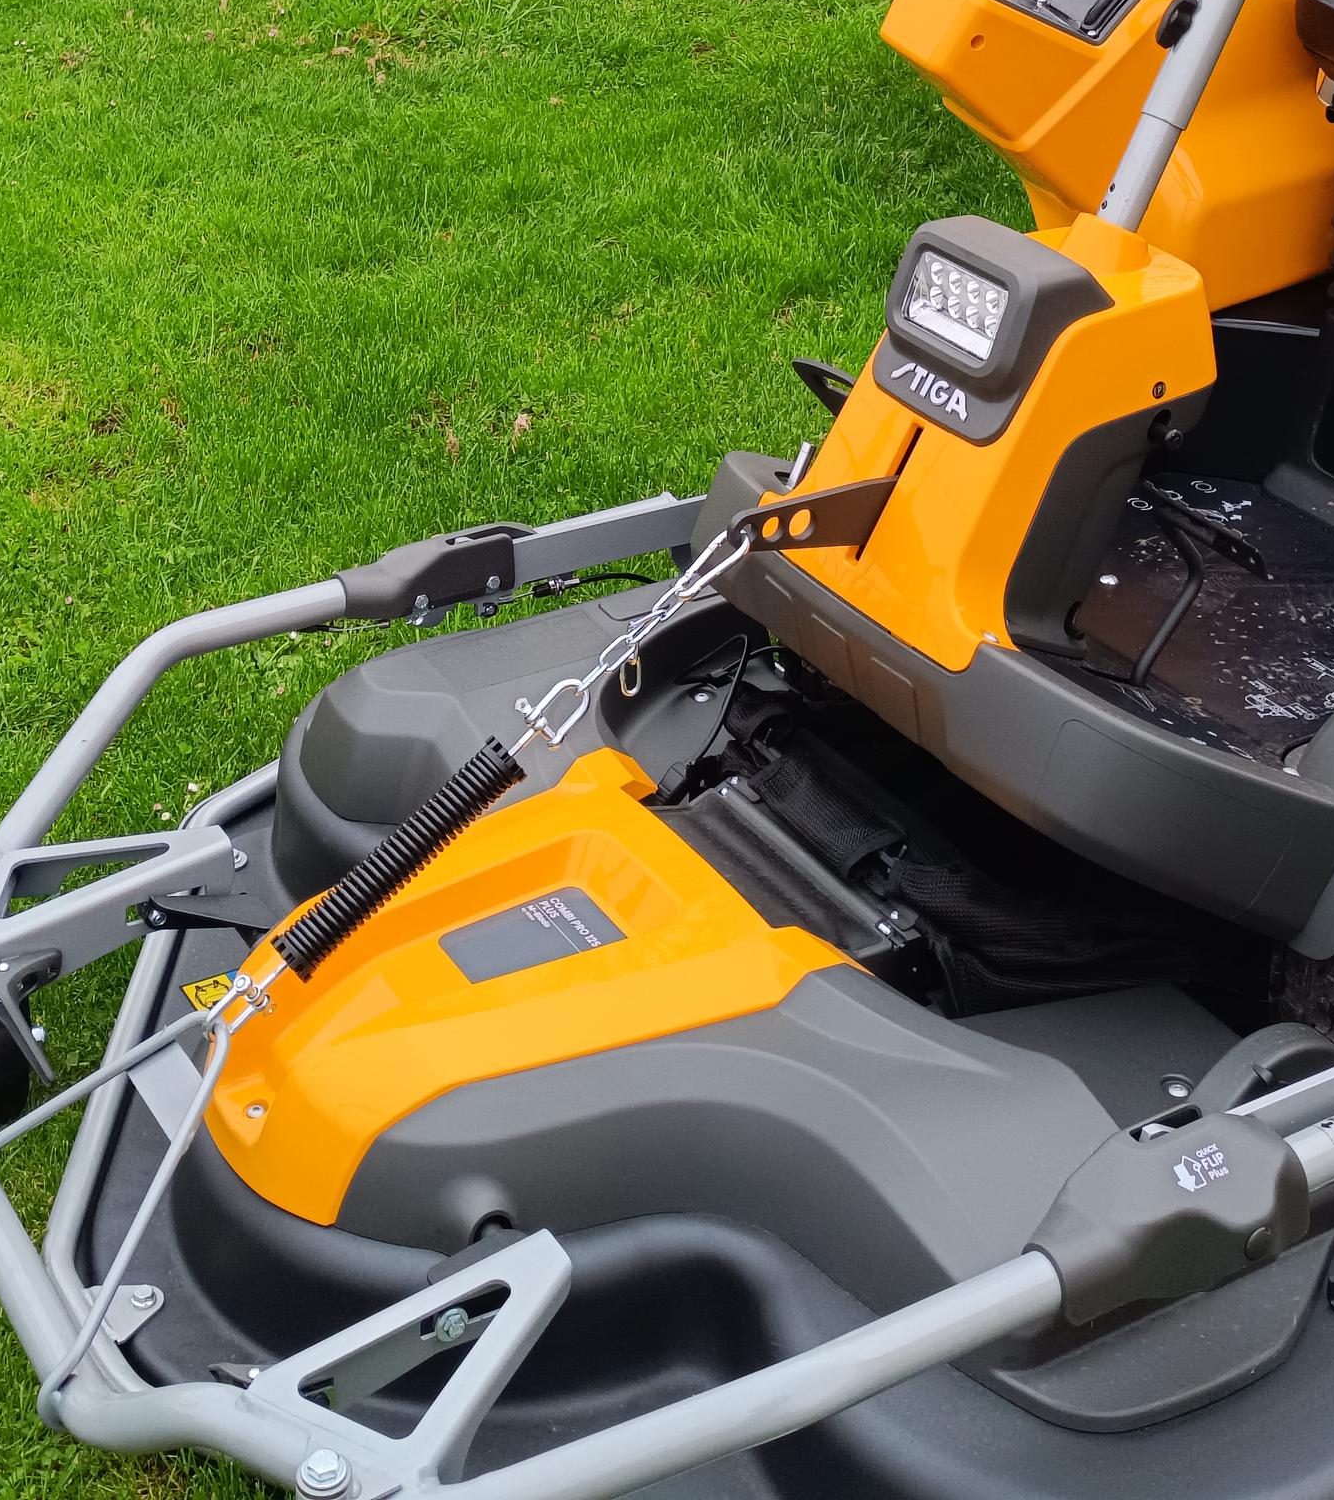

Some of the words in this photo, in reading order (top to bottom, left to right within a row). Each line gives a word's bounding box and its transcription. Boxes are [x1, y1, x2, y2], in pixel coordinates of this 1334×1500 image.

[890, 362, 968, 423] STIGA
[539, 900, 560, 919] PLUS
[550, 897, 577, 922] COMBI
[570, 919, 590, 936] PRO
[584, 933, 602, 948] 125
[1196, 1143, 1219, 1158] QUICK
[1200, 1152, 1224, 1171] FLIP
